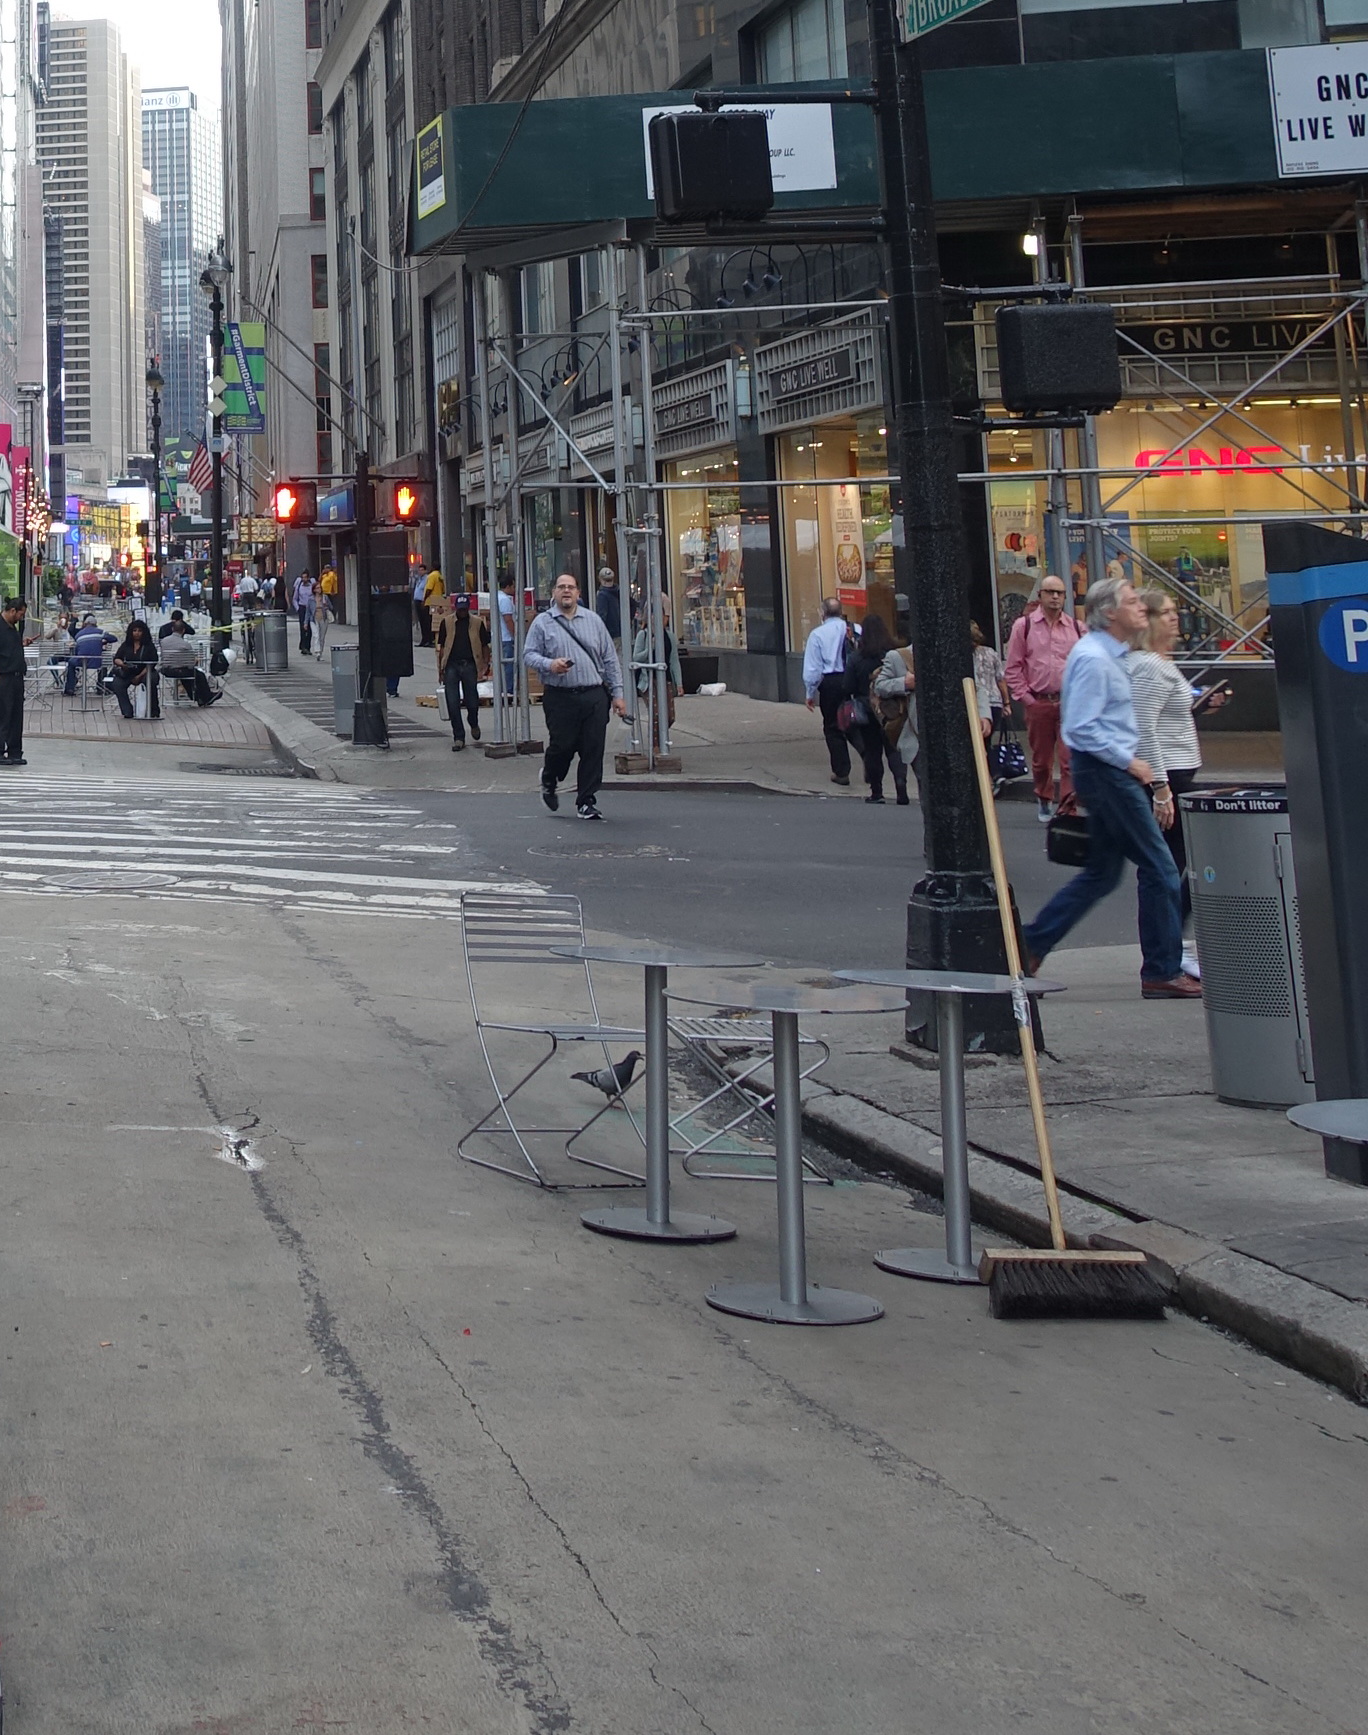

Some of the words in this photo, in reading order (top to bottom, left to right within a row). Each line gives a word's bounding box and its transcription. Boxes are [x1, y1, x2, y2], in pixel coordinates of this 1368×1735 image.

[1317, 72, 1368, 102] GNC
[1286, 117, 1335, 142] LIVE
[784, 148, 796, 157] LLC.
[1153, 326, 1231, 351] GNC
[1252, 323, 1326, 347] LIVE
[230, 329, 257, 406] #GarmentDistrict
[781, 372, 798, 393] GNC
[800, 364, 817, 387] LIVE
[819, 358, 839, 382] WELL
[1135, 446, 1284, 477] GNC
[1342, 609, 1368, 663] P
[1215, 800, 1246, 810] Don't
[1249, 800, 1281, 810] litter
